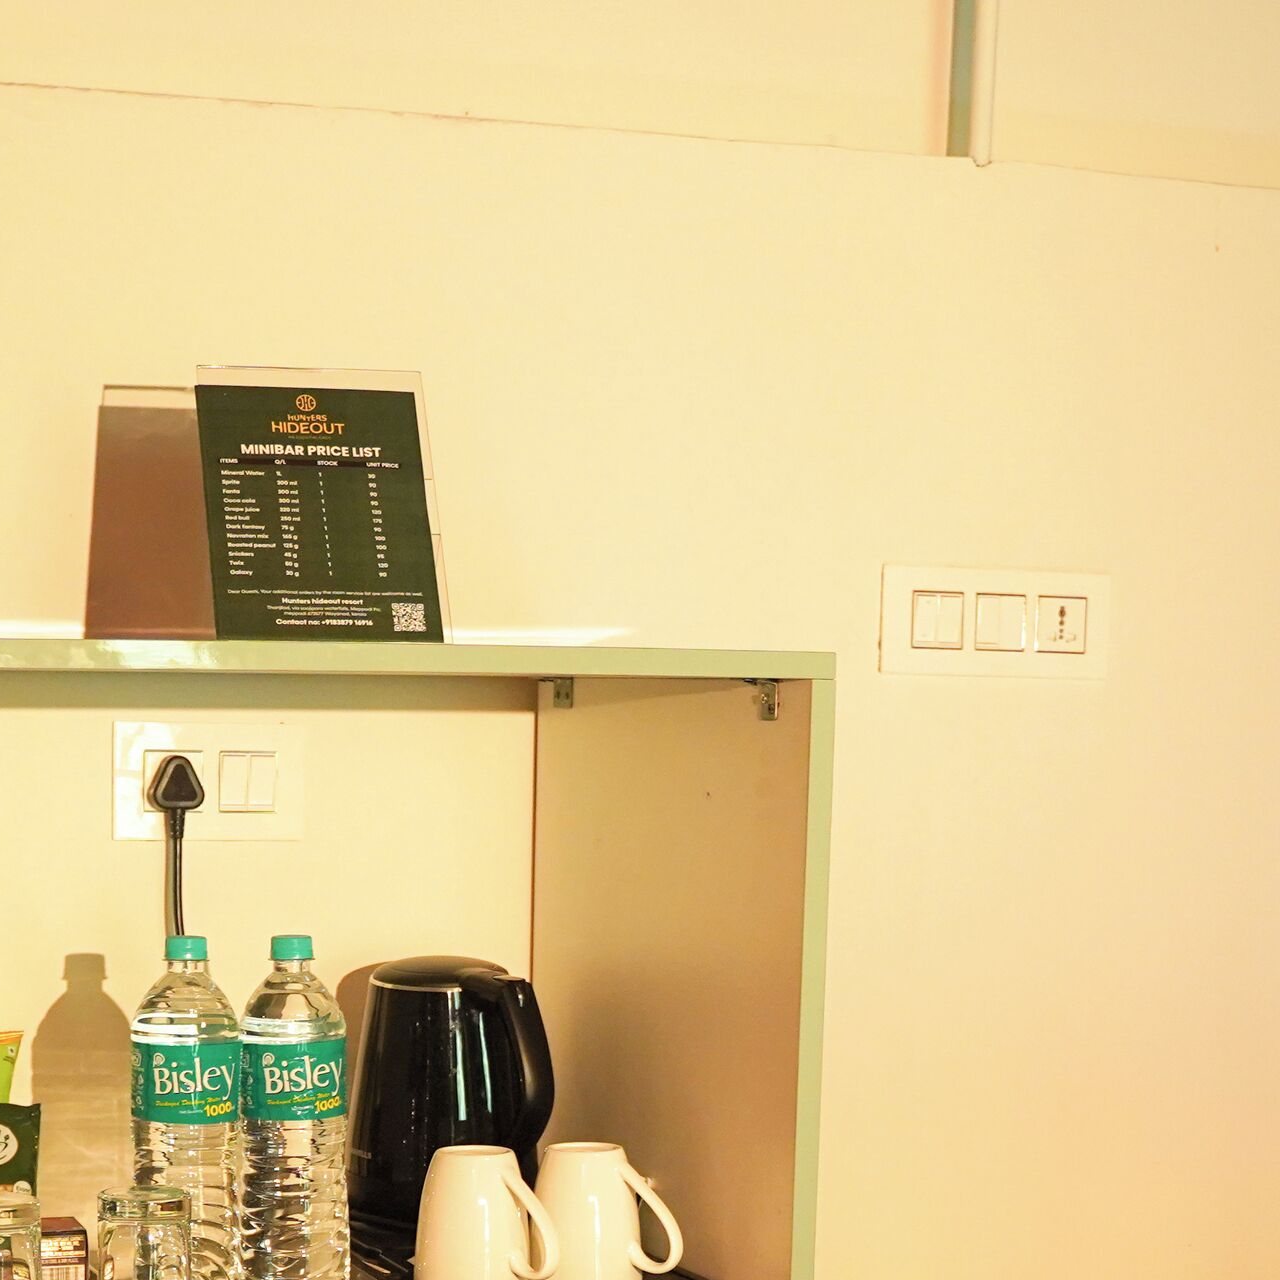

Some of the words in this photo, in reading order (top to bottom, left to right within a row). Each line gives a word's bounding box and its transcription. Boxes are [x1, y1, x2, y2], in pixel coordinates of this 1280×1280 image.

[287, 413, 328, 421] HUNTERS
[271, 421, 345, 435] HIDEOUT
[240, 443, 304, 456] MINIBAR
[307, 445, 349, 457] PRICE
[352, 446, 382, 458] LIST
[153, 1056, 235, 1101] Bisley
[263, 1054, 342, 1097] Bisley
[204, 1101, 232, 1117] 1000
[314, 1096, 340, 1112] 1000
